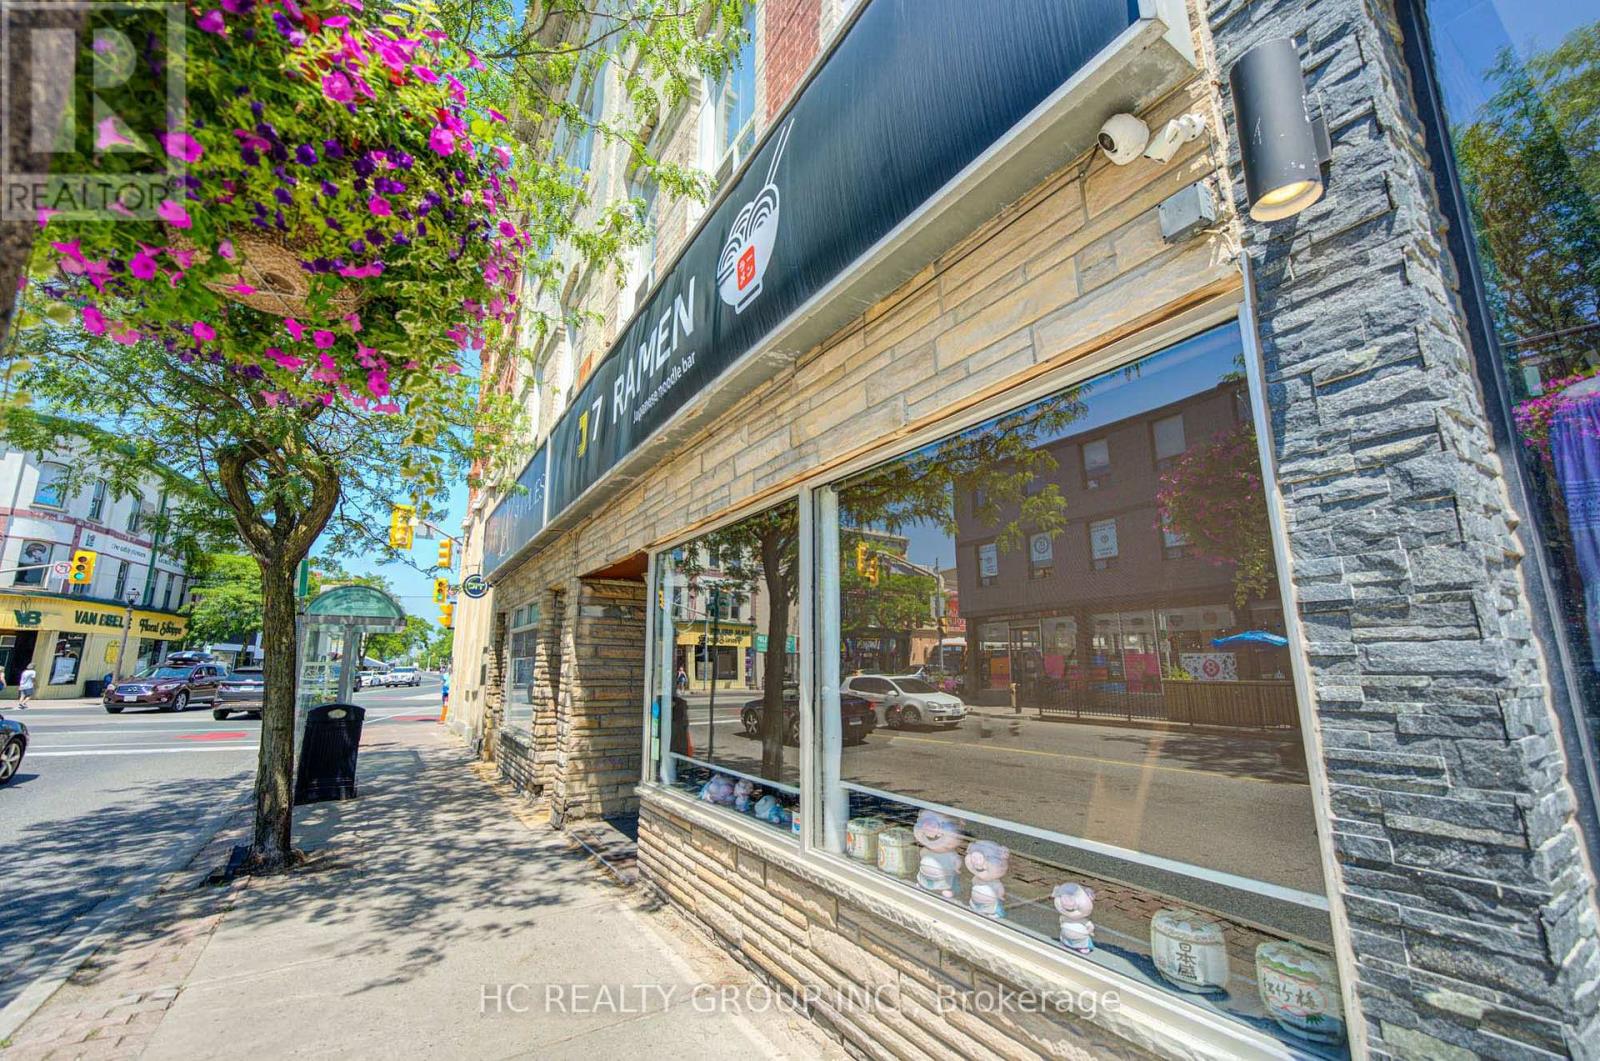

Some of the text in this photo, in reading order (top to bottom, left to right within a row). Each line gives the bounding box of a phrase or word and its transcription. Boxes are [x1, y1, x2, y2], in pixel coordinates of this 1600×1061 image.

[613, 275, 696, 424] RAMEN
[658, 365, 682, 398] noodle
[682, 352, 696, 373] bar
[75, 609, 97, 624] VAN
